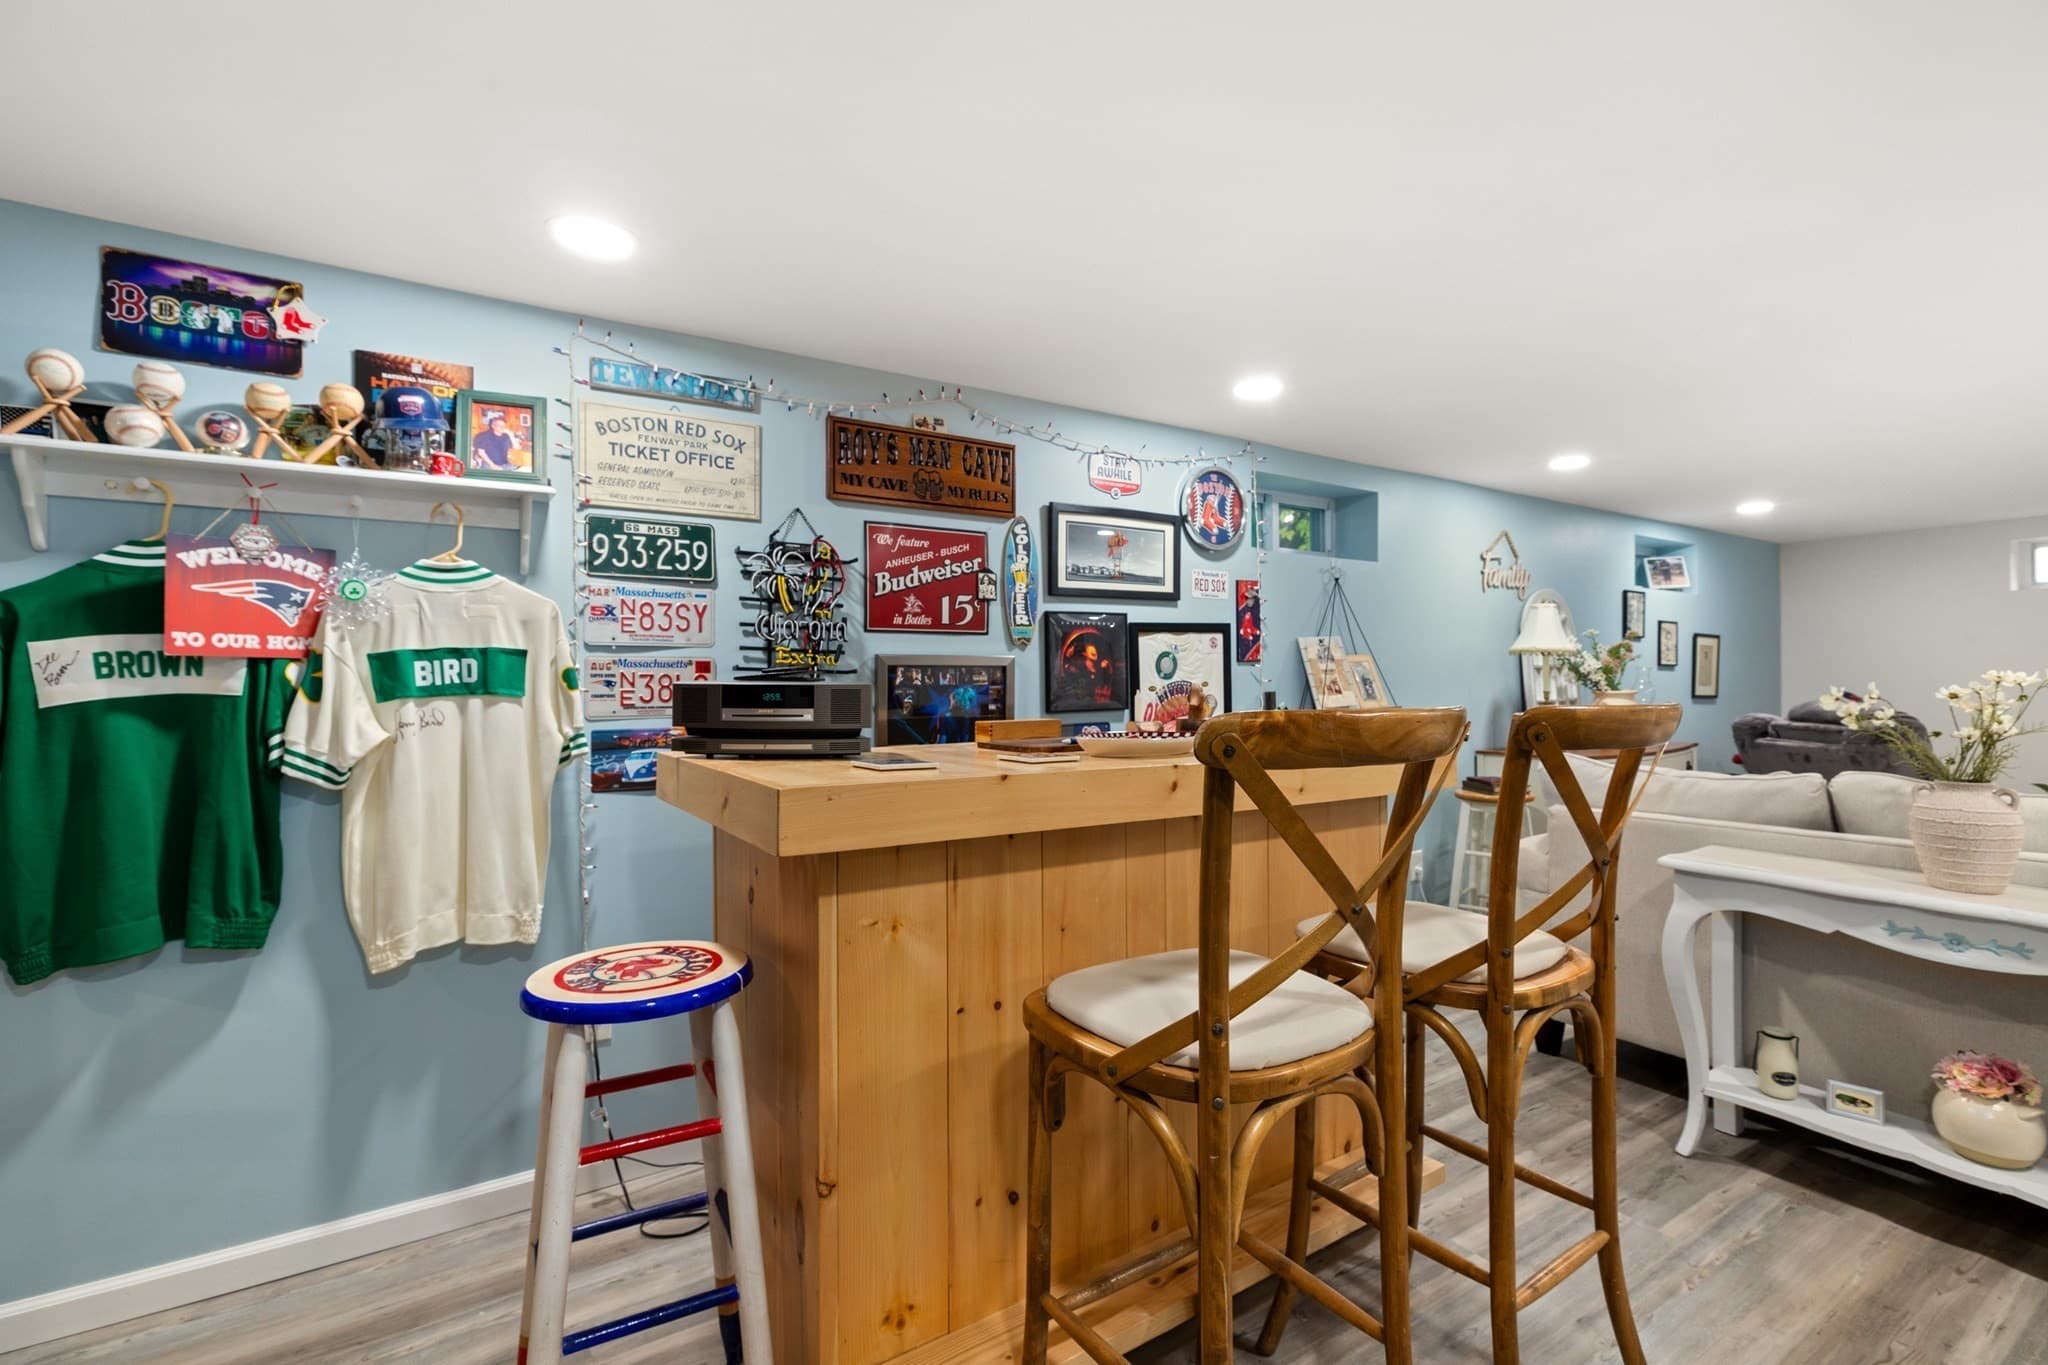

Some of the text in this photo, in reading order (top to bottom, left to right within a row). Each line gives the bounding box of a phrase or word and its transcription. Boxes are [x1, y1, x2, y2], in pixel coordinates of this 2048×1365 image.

[106, 279, 292, 344] BOSTO
[595, 416, 747, 454] BOSTON RED SOX
[638, 434, 708, 450] FENWAY PARK
[608, 442, 735, 470] TICKET OFFICE
[908, 437, 951, 470] MAN
[961, 444, 1011, 486] CAVE
[1103, 455, 1127, 468] STAY
[598, 476, 637, 488] RESERVED
[1097, 466, 1133, 481] AWHILE
[840, 472, 1009, 504] MY CAVE MY RULES
[625, 523, 678, 536] 66 MASS
[872, 533, 930, 552] We feature
[885, 550, 934, 569] ANHEUSER
[940, 543, 970, 557] BUSCH
[1013, 523, 1029, 564] COLD
[176, 547, 326, 582] WELOME
[873, 556, 982, 597] Budweiser
[1480, 550, 1532, 600] Family
[588, 586, 686, 600] MAR Massachusetts
[1194, 577, 1226, 593] RED SOX
[1014, 583, 1030, 626] BEER
[755, 613, 848, 644] Corona
[893, 613, 933, 626] in Bottles
[171, 631, 314, 650] TO OUR HOM
[92, 650, 204, 679] BROWN
[590, 658, 689, 671] AUG Massachusetts
[775, 646, 840, 666] Extra
[413, 658, 478, 687] BIRD
